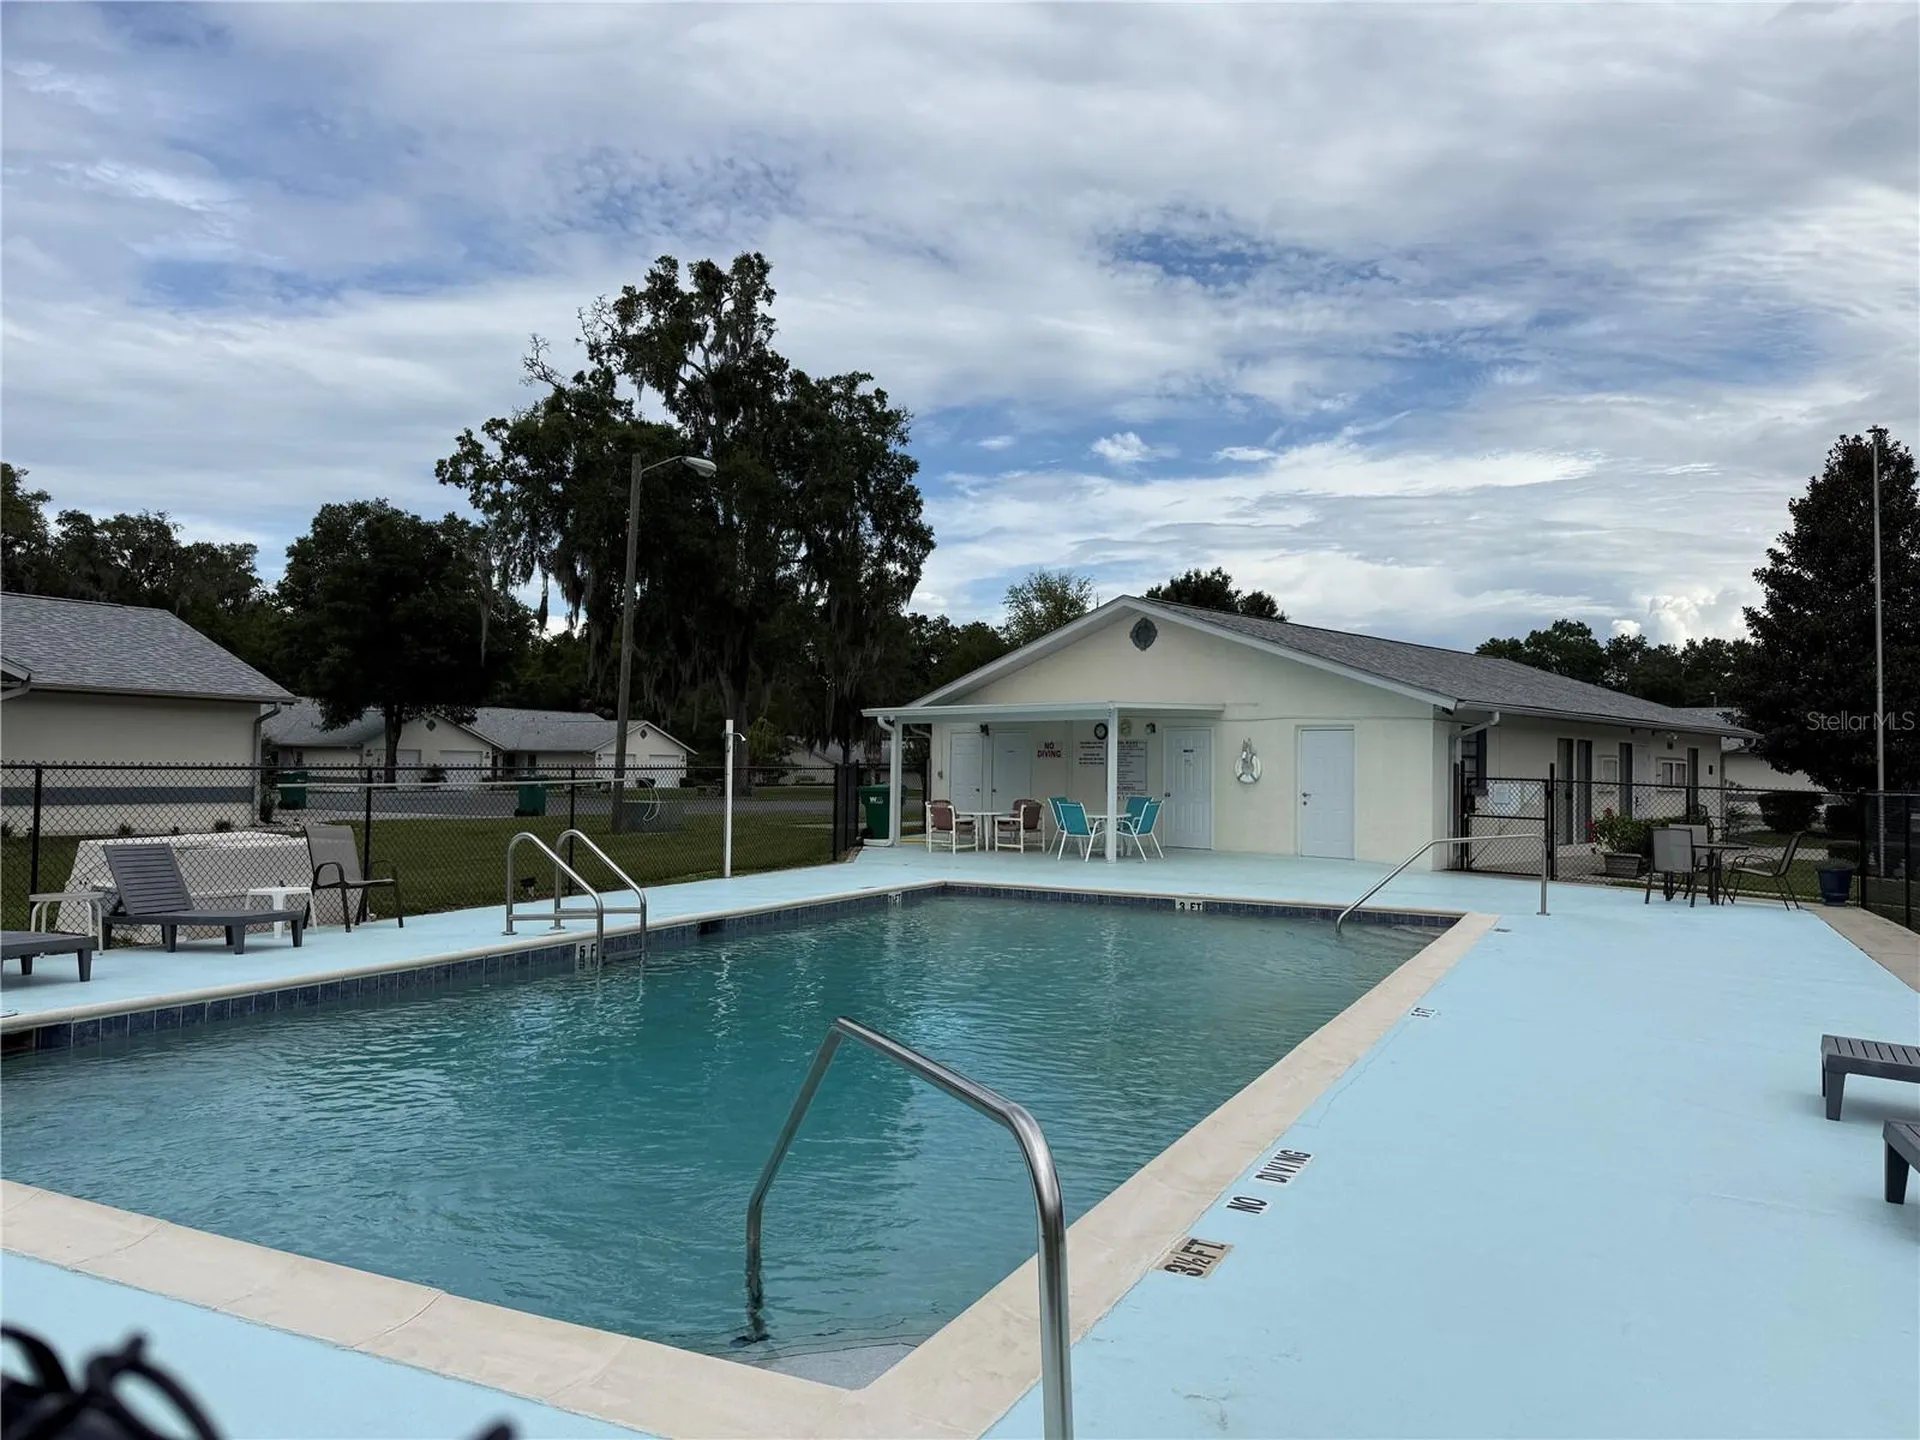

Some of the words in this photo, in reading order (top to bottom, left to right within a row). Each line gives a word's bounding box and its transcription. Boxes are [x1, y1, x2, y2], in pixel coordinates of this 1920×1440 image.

[1044, 741, 1054, 749] NO
[1037, 750, 1061, 758] DIVING
[1226, 1196, 1267, 1214] NO
[1255, 1149, 1311, 1183] DIVING
